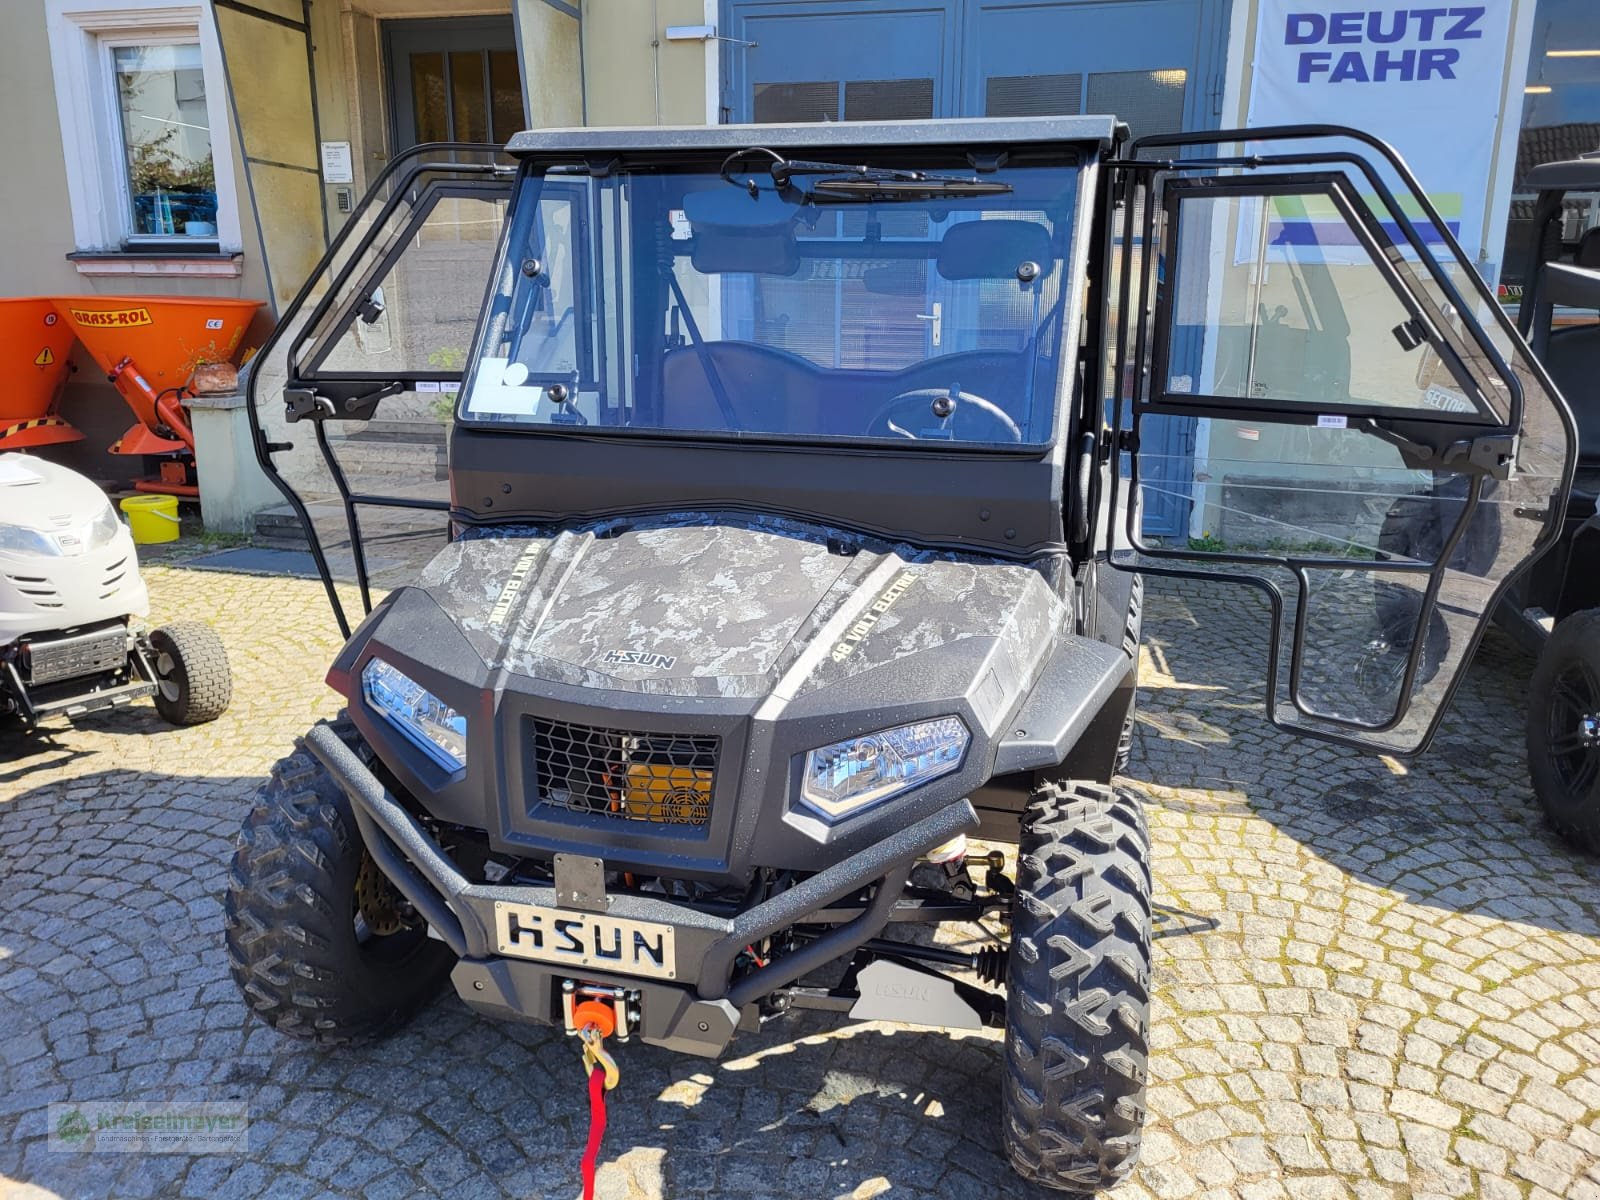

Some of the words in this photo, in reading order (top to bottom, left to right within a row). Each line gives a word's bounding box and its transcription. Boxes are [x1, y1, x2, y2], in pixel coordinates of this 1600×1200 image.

[1285, 7, 1485, 45] DEUTZ
[1297, 48, 1460, 83] FAHR
[74, 309, 149, 325] GRASS-ROL
[511, 555, 536, 577] VOLT
[488, 580, 522, 625] ELECTRIC
[831, 642, 854, 663] 48
[846, 612, 879, 641] VOLT
[871, 571, 920, 613] ELECTRIC
